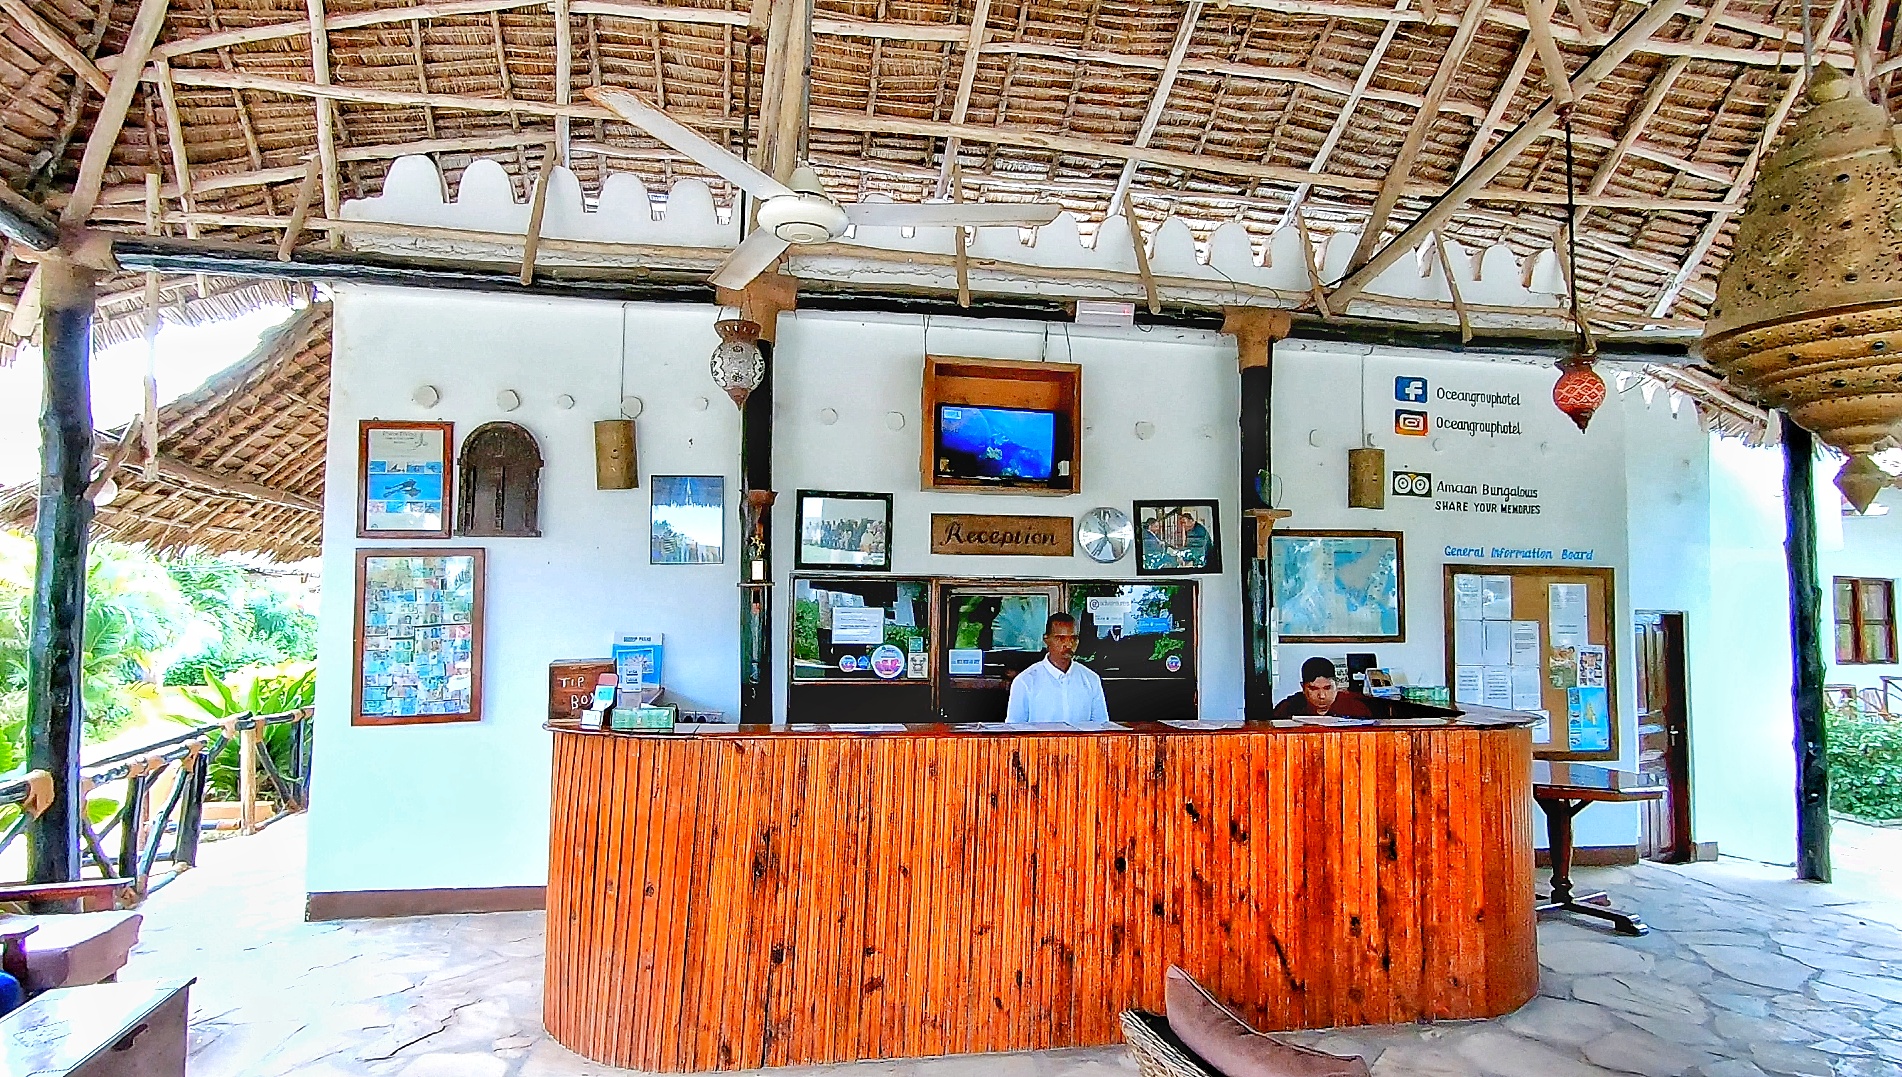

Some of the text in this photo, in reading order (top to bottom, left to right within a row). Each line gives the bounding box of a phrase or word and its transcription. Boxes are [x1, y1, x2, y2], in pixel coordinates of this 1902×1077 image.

[1436, 387, 1521, 408] Oceangrouphotel
[1436, 416, 1523, 437] Oceangrouphotel
[1436, 480, 1477, 495] Amaan
[1435, 500, 1541, 515] SHARE YOUR MEMORIES
[939, 521, 1059, 548] Reception
[1444, 545, 1594, 561] General Information Board
[557, 676, 585, 688] TIP
